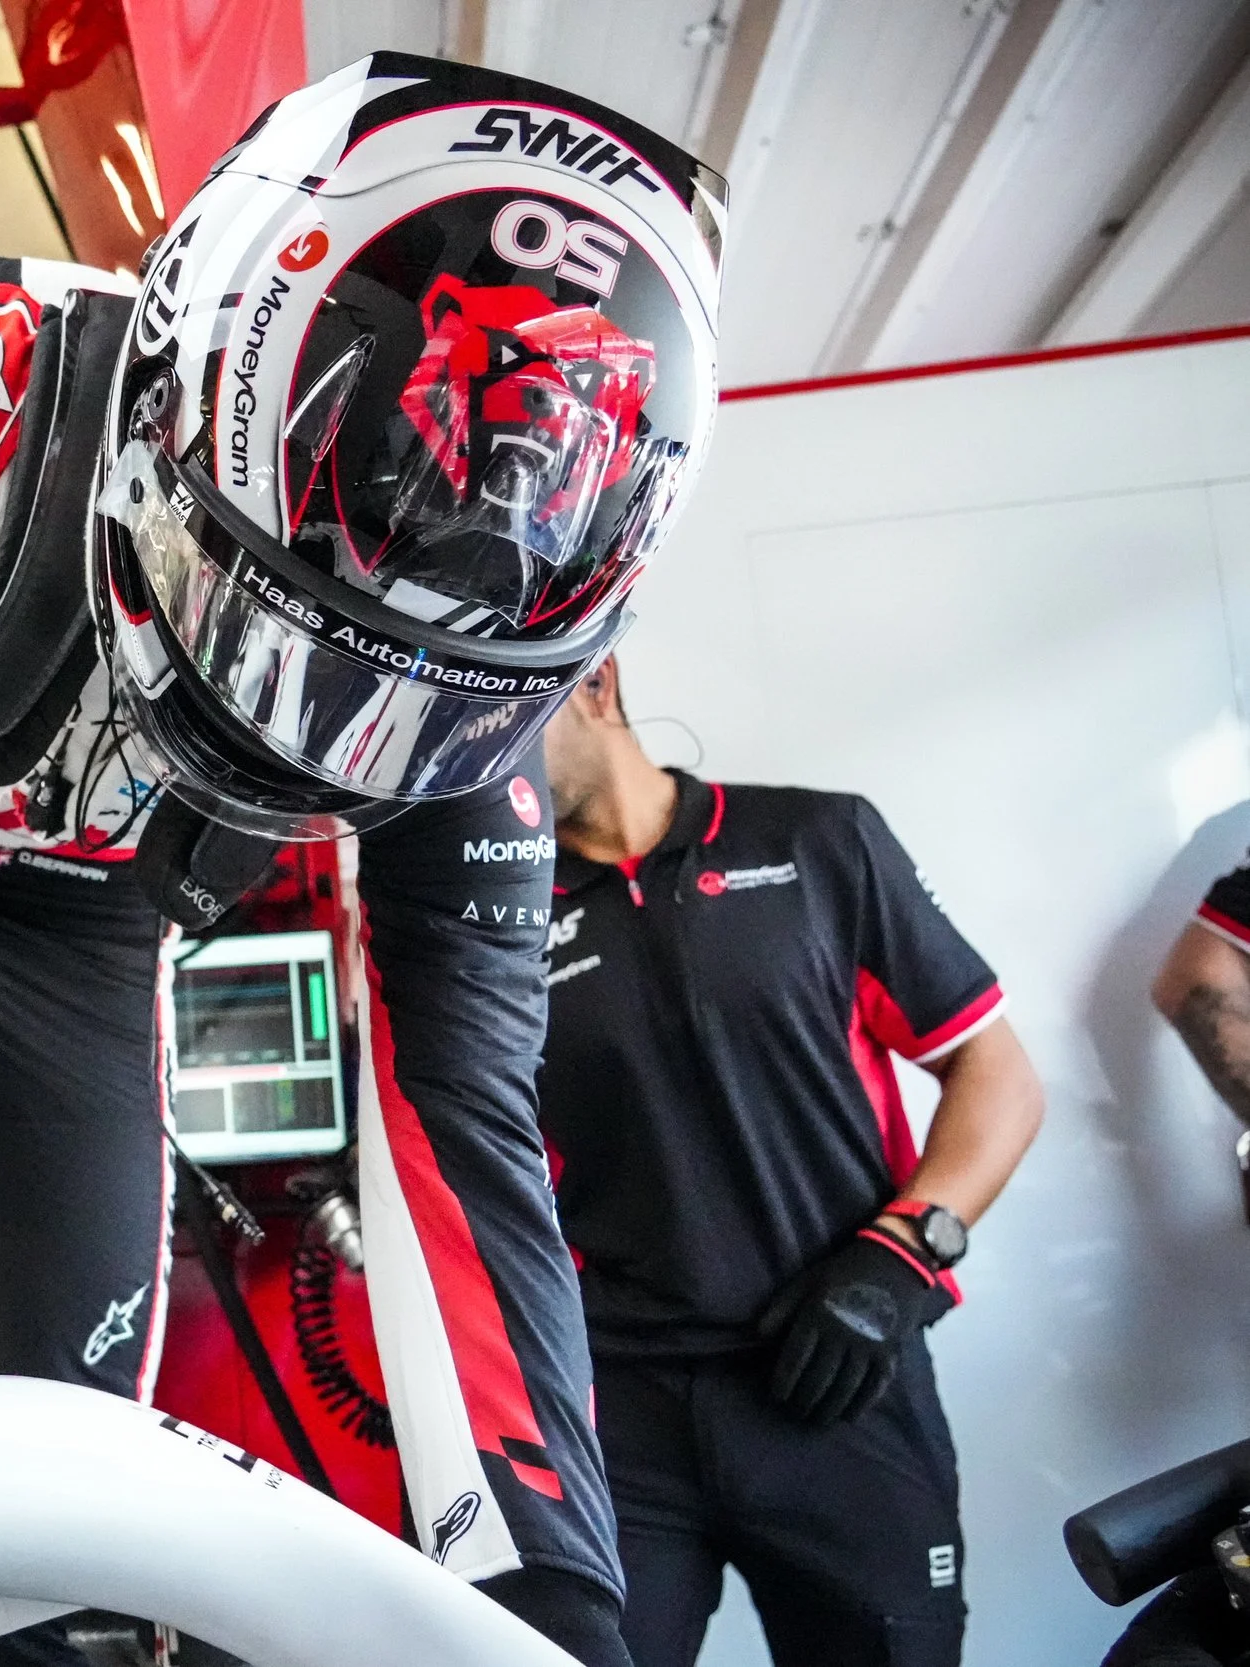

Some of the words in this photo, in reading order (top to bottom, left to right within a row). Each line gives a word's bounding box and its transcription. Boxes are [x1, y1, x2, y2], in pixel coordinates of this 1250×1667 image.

[491, 200, 628, 299] 50
[231, 276, 291, 487] MoneyGram
[243, 565, 325, 630] Haas
[330, 625, 517, 692] Automation
[522, 675, 559, 692] Inc.
[463, 834, 556, 866] MoneyGr
[180, 875, 227, 923] EXGE
[460, 900, 550, 927] AVEN
